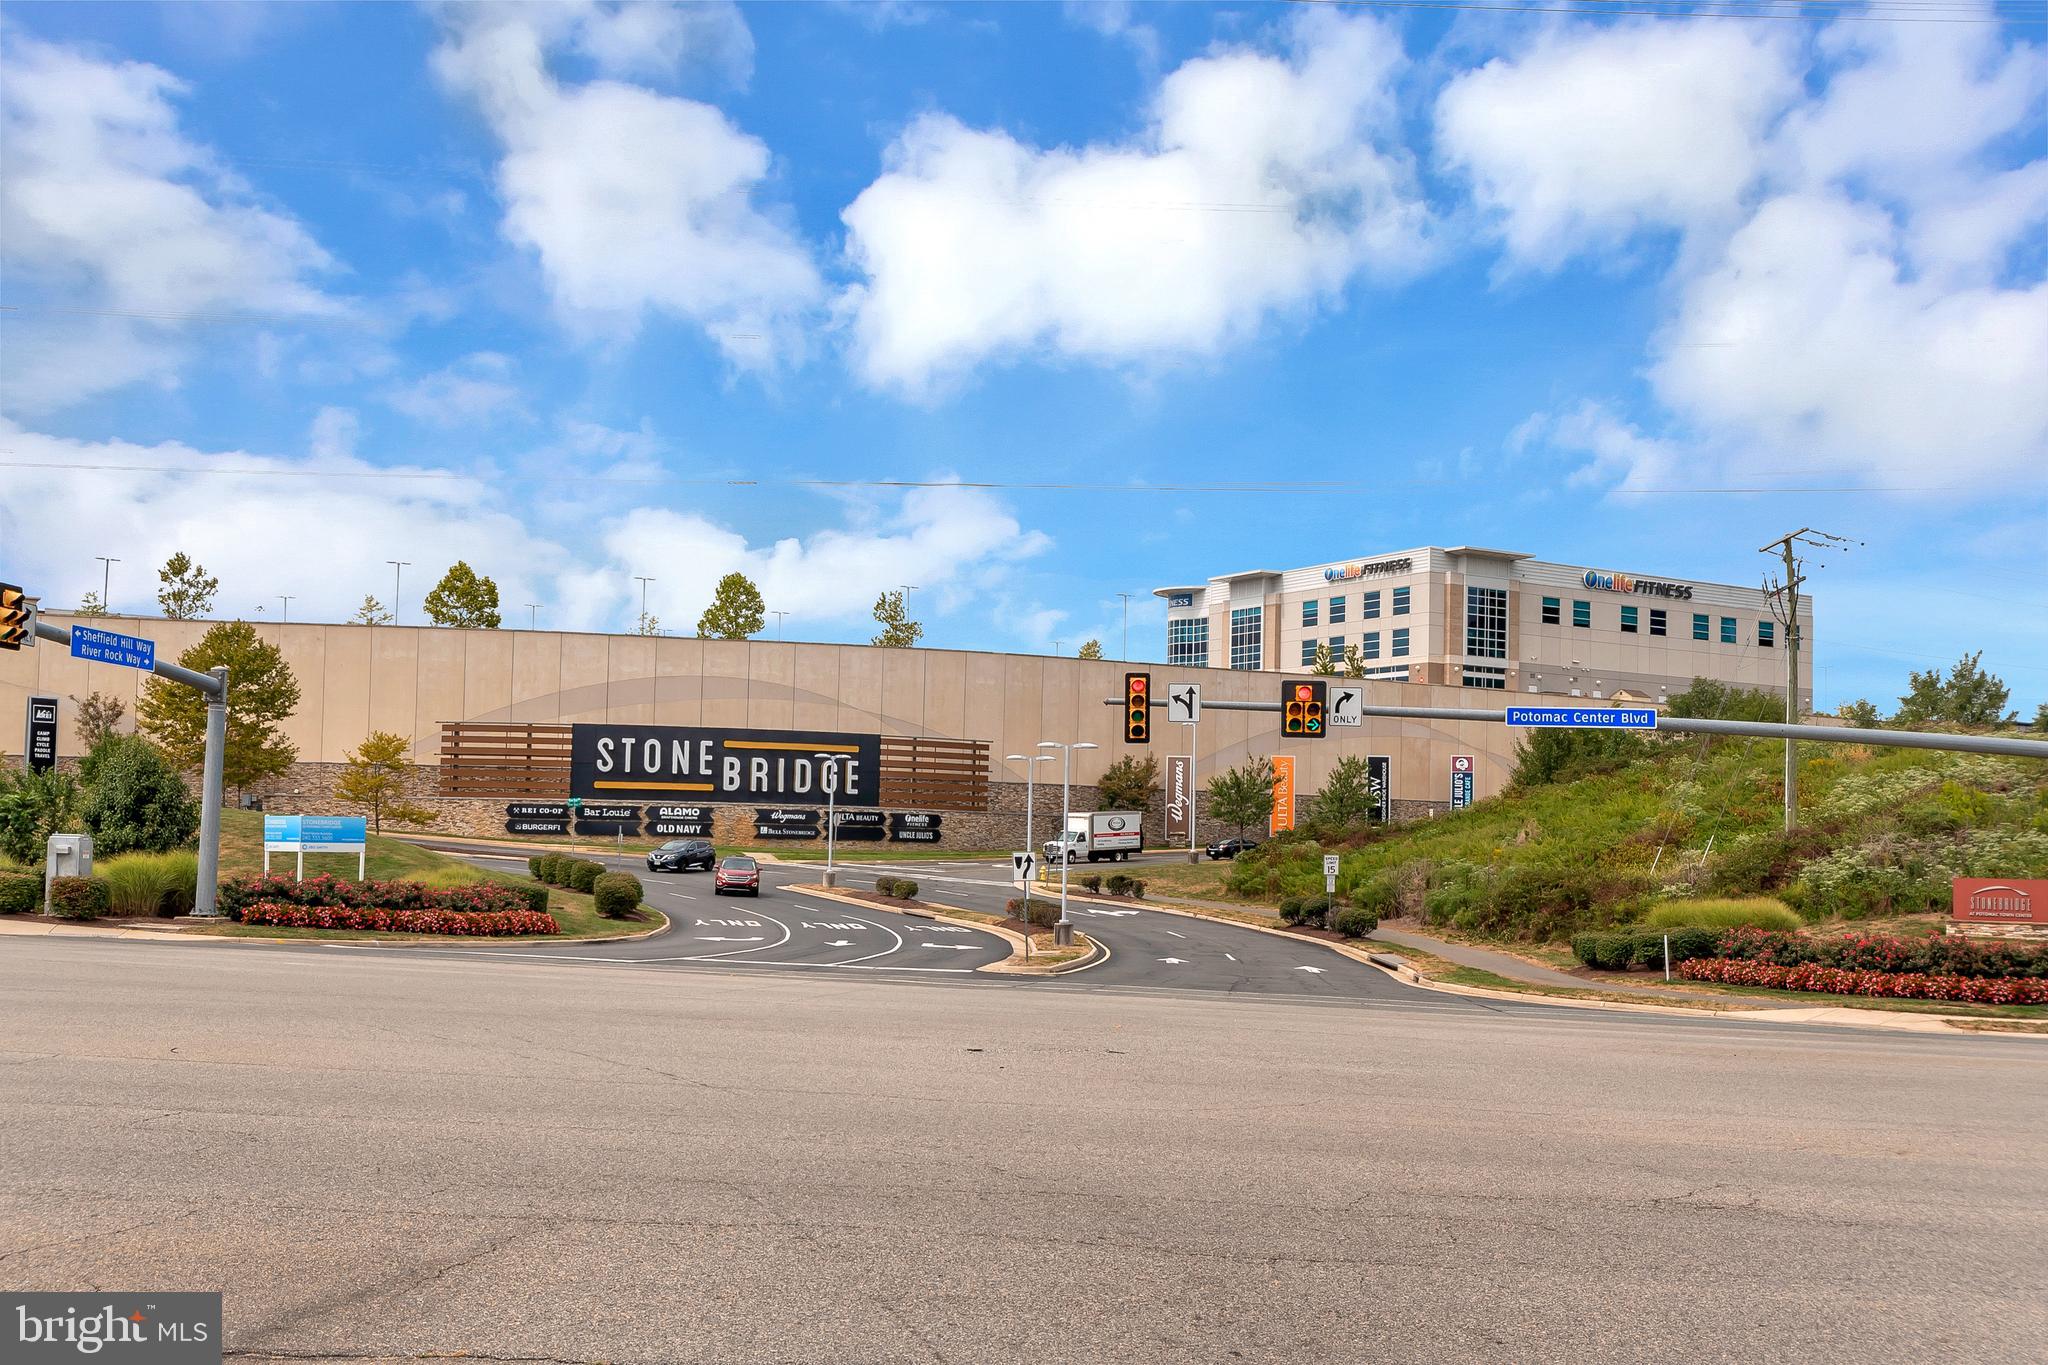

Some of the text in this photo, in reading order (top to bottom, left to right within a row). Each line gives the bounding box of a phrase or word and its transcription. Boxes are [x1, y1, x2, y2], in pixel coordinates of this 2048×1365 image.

[1361, 557, 1412, 576] FITNESS
[1583, 570, 1694, 600] Onelife FITNESS
[82, 630, 152, 655] Sheffield Hill Way
[81, 644, 141, 667] River Rock Way
[1333, 715, 1357, 723] ONLY
[1513, 711, 1648, 724] Potomac Center Blvd
[596, 737, 714, 775] STONE
[722, 756, 859, 795] BRIDGE
[1167, 760, 1189, 823] Wegmans
[1454, 773, 1464, 798] JULIO'S
[584, 808, 631, 817] Bar Louie
[659, 807, 700, 816] ALAMO
[770, 809, 806, 823] Wegmans
[838, 813, 855, 821] LTA
[1278, 797, 1288, 826] ULTA
[656, 824, 701, 834] OLD NAVY
[899, 831, 933, 840] UNCLE JULIO'S
[1327, 865, 1335, 873] 15
[1970, 896, 2032, 911] STONEBRIDGE
